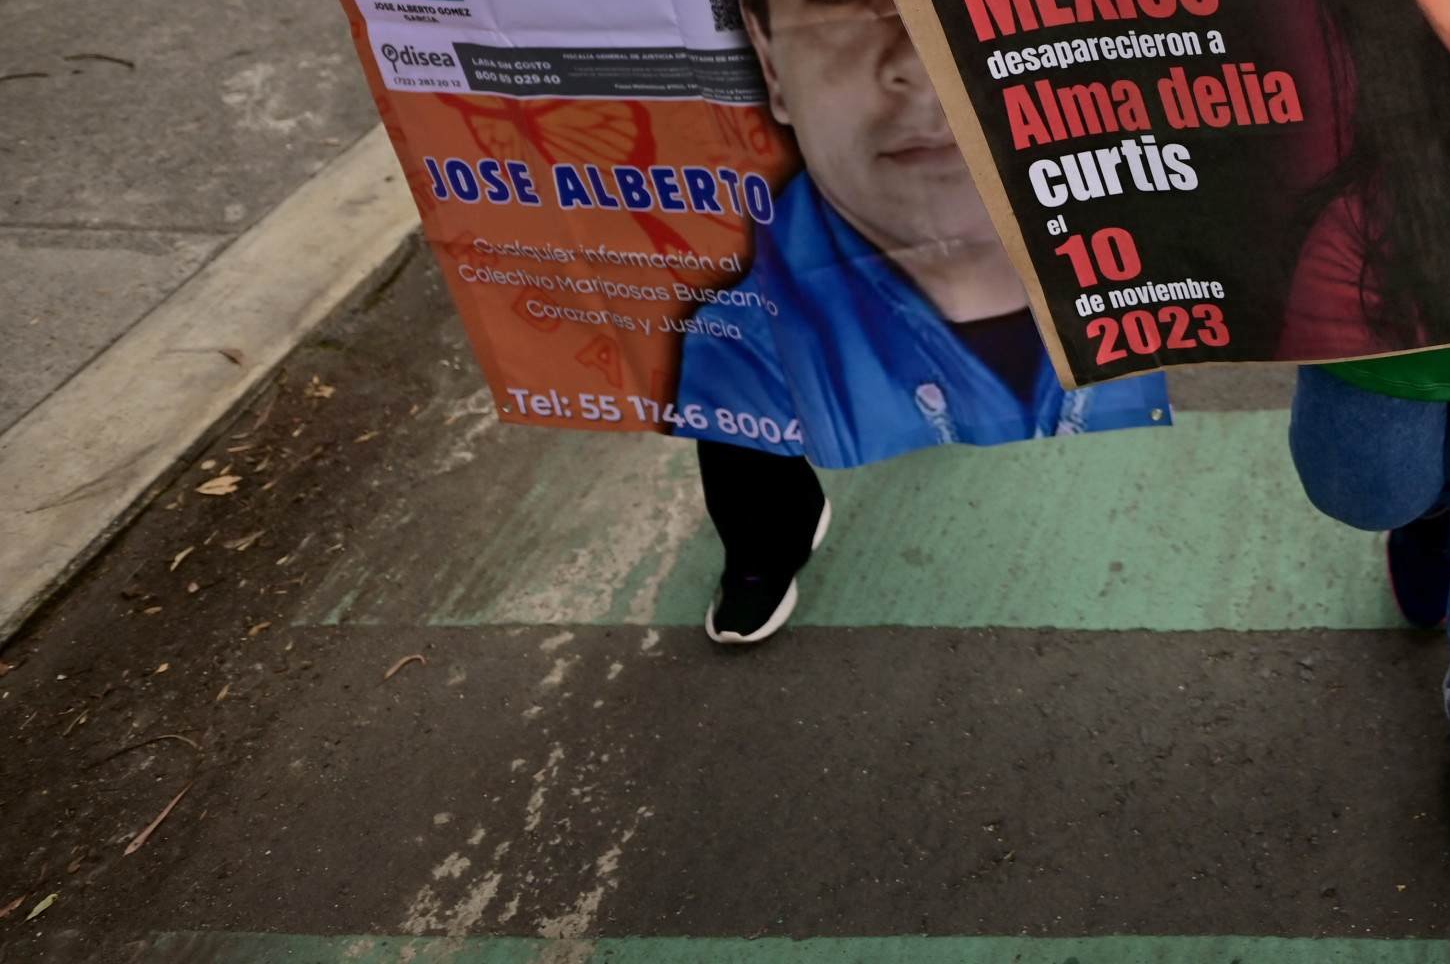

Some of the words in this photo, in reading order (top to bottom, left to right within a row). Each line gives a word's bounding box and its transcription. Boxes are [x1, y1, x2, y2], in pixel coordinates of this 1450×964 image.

[397, 4, 436, 15] ALBERTO
[514, 59, 552, 70] COSTO
[986, 30, 1203, 80] desaparecieron
[1206, 29, 1226, 55] a
[1002, 78, 1152, 151] Alma
[1157, 61, 1304, 131] delia
[423, 156, 541, 207] JOSE
[553, 163, 774, 225] ALBERTO
[1028, 134, 1199, 208] curtis
[1046, 214, 1068, 236] el
[472, 237, 577, 267] Cualquier
[580, 241, 716, 271] información
[719, 251, 741, 273] al
[1054, 227, 1142, 288] 10
[459, 264, 553, 293] Colectivo
[556, 276, 670, 302] Mariposas
[1075, 293, 1105, 318] de
[1108, 278, 1225, 309] noviembre
[526, 299, 635, 331] Corazones
[637, 317, 651, 336] y
[658, 316, 742, 341] Justicia
[1086, 303, 1230, 366] 2023
[507, 387, 572, 418] Tel:
[579, 392, 621, 422] 55
[715, 408, 804, 445] 8004
